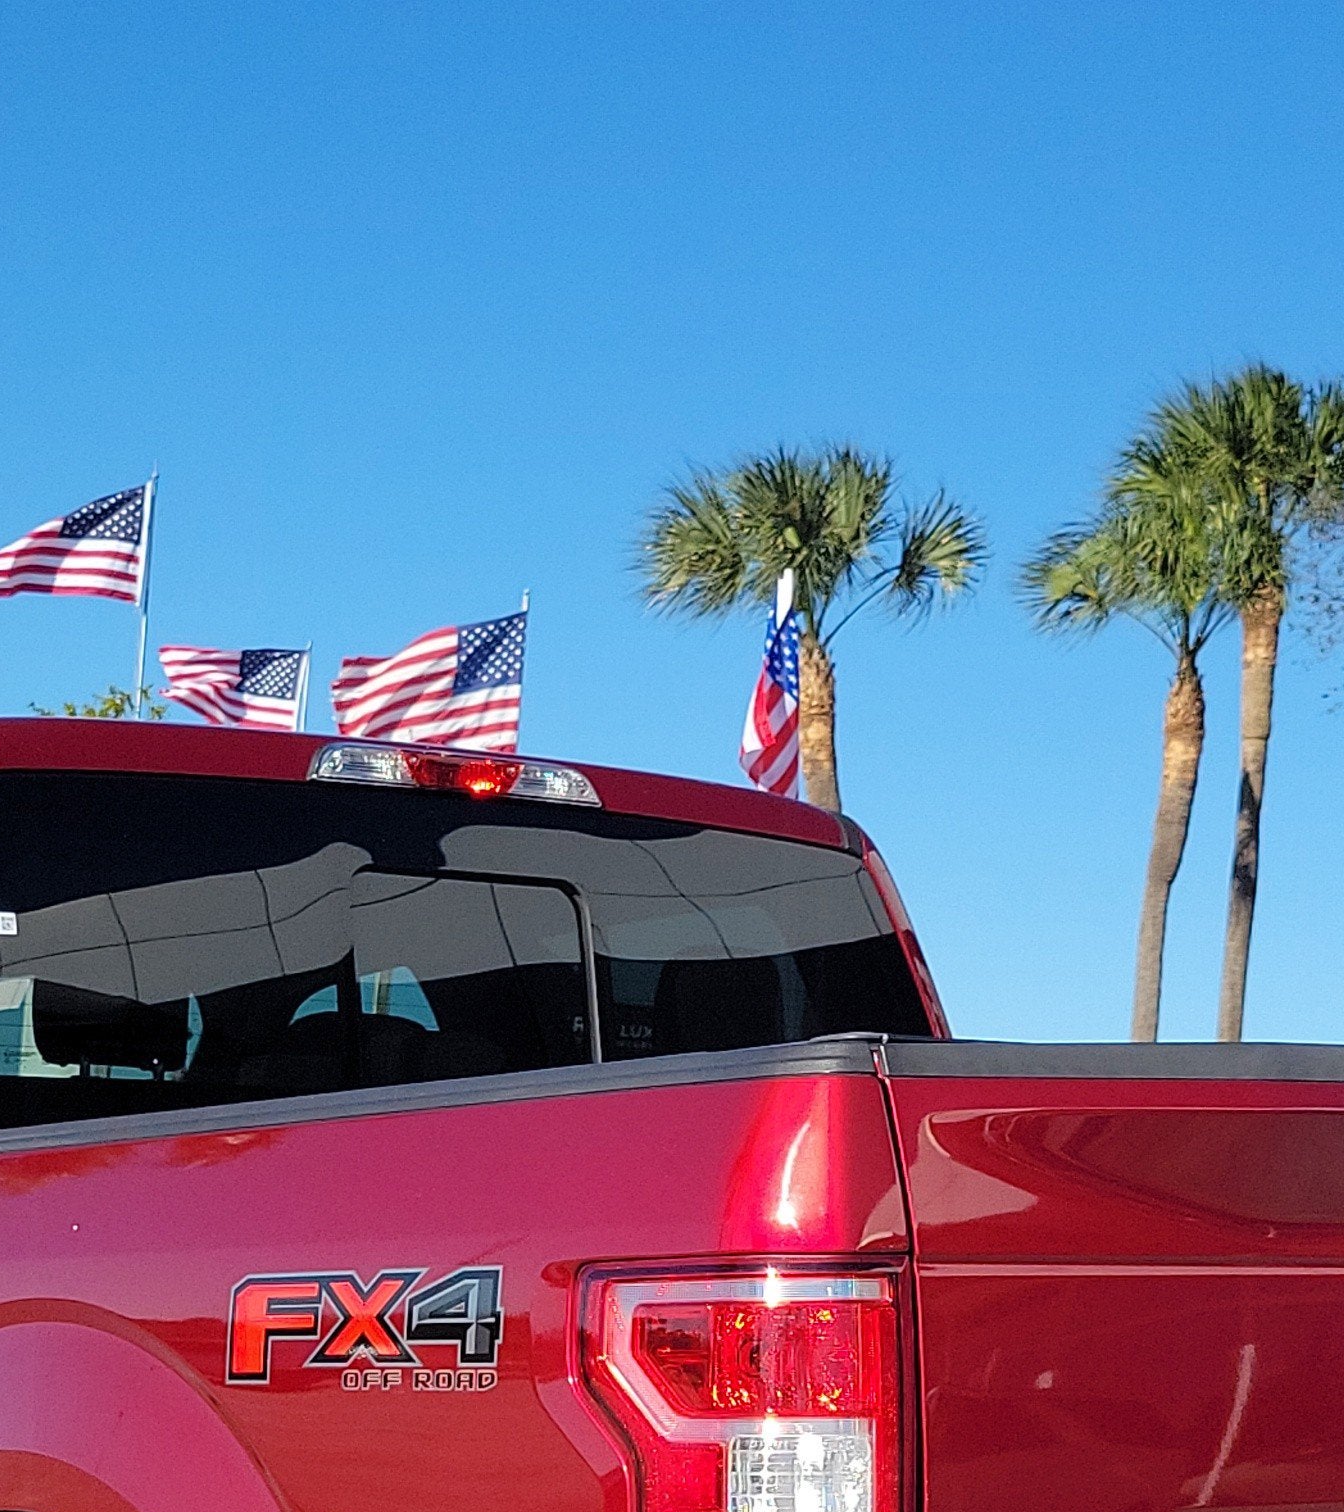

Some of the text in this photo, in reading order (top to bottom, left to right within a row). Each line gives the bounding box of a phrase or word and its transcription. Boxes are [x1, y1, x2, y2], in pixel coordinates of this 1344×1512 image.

[226, 1265, 504, 1385] FX4
[342, 1369, 498, 1391] OFF ROAD
